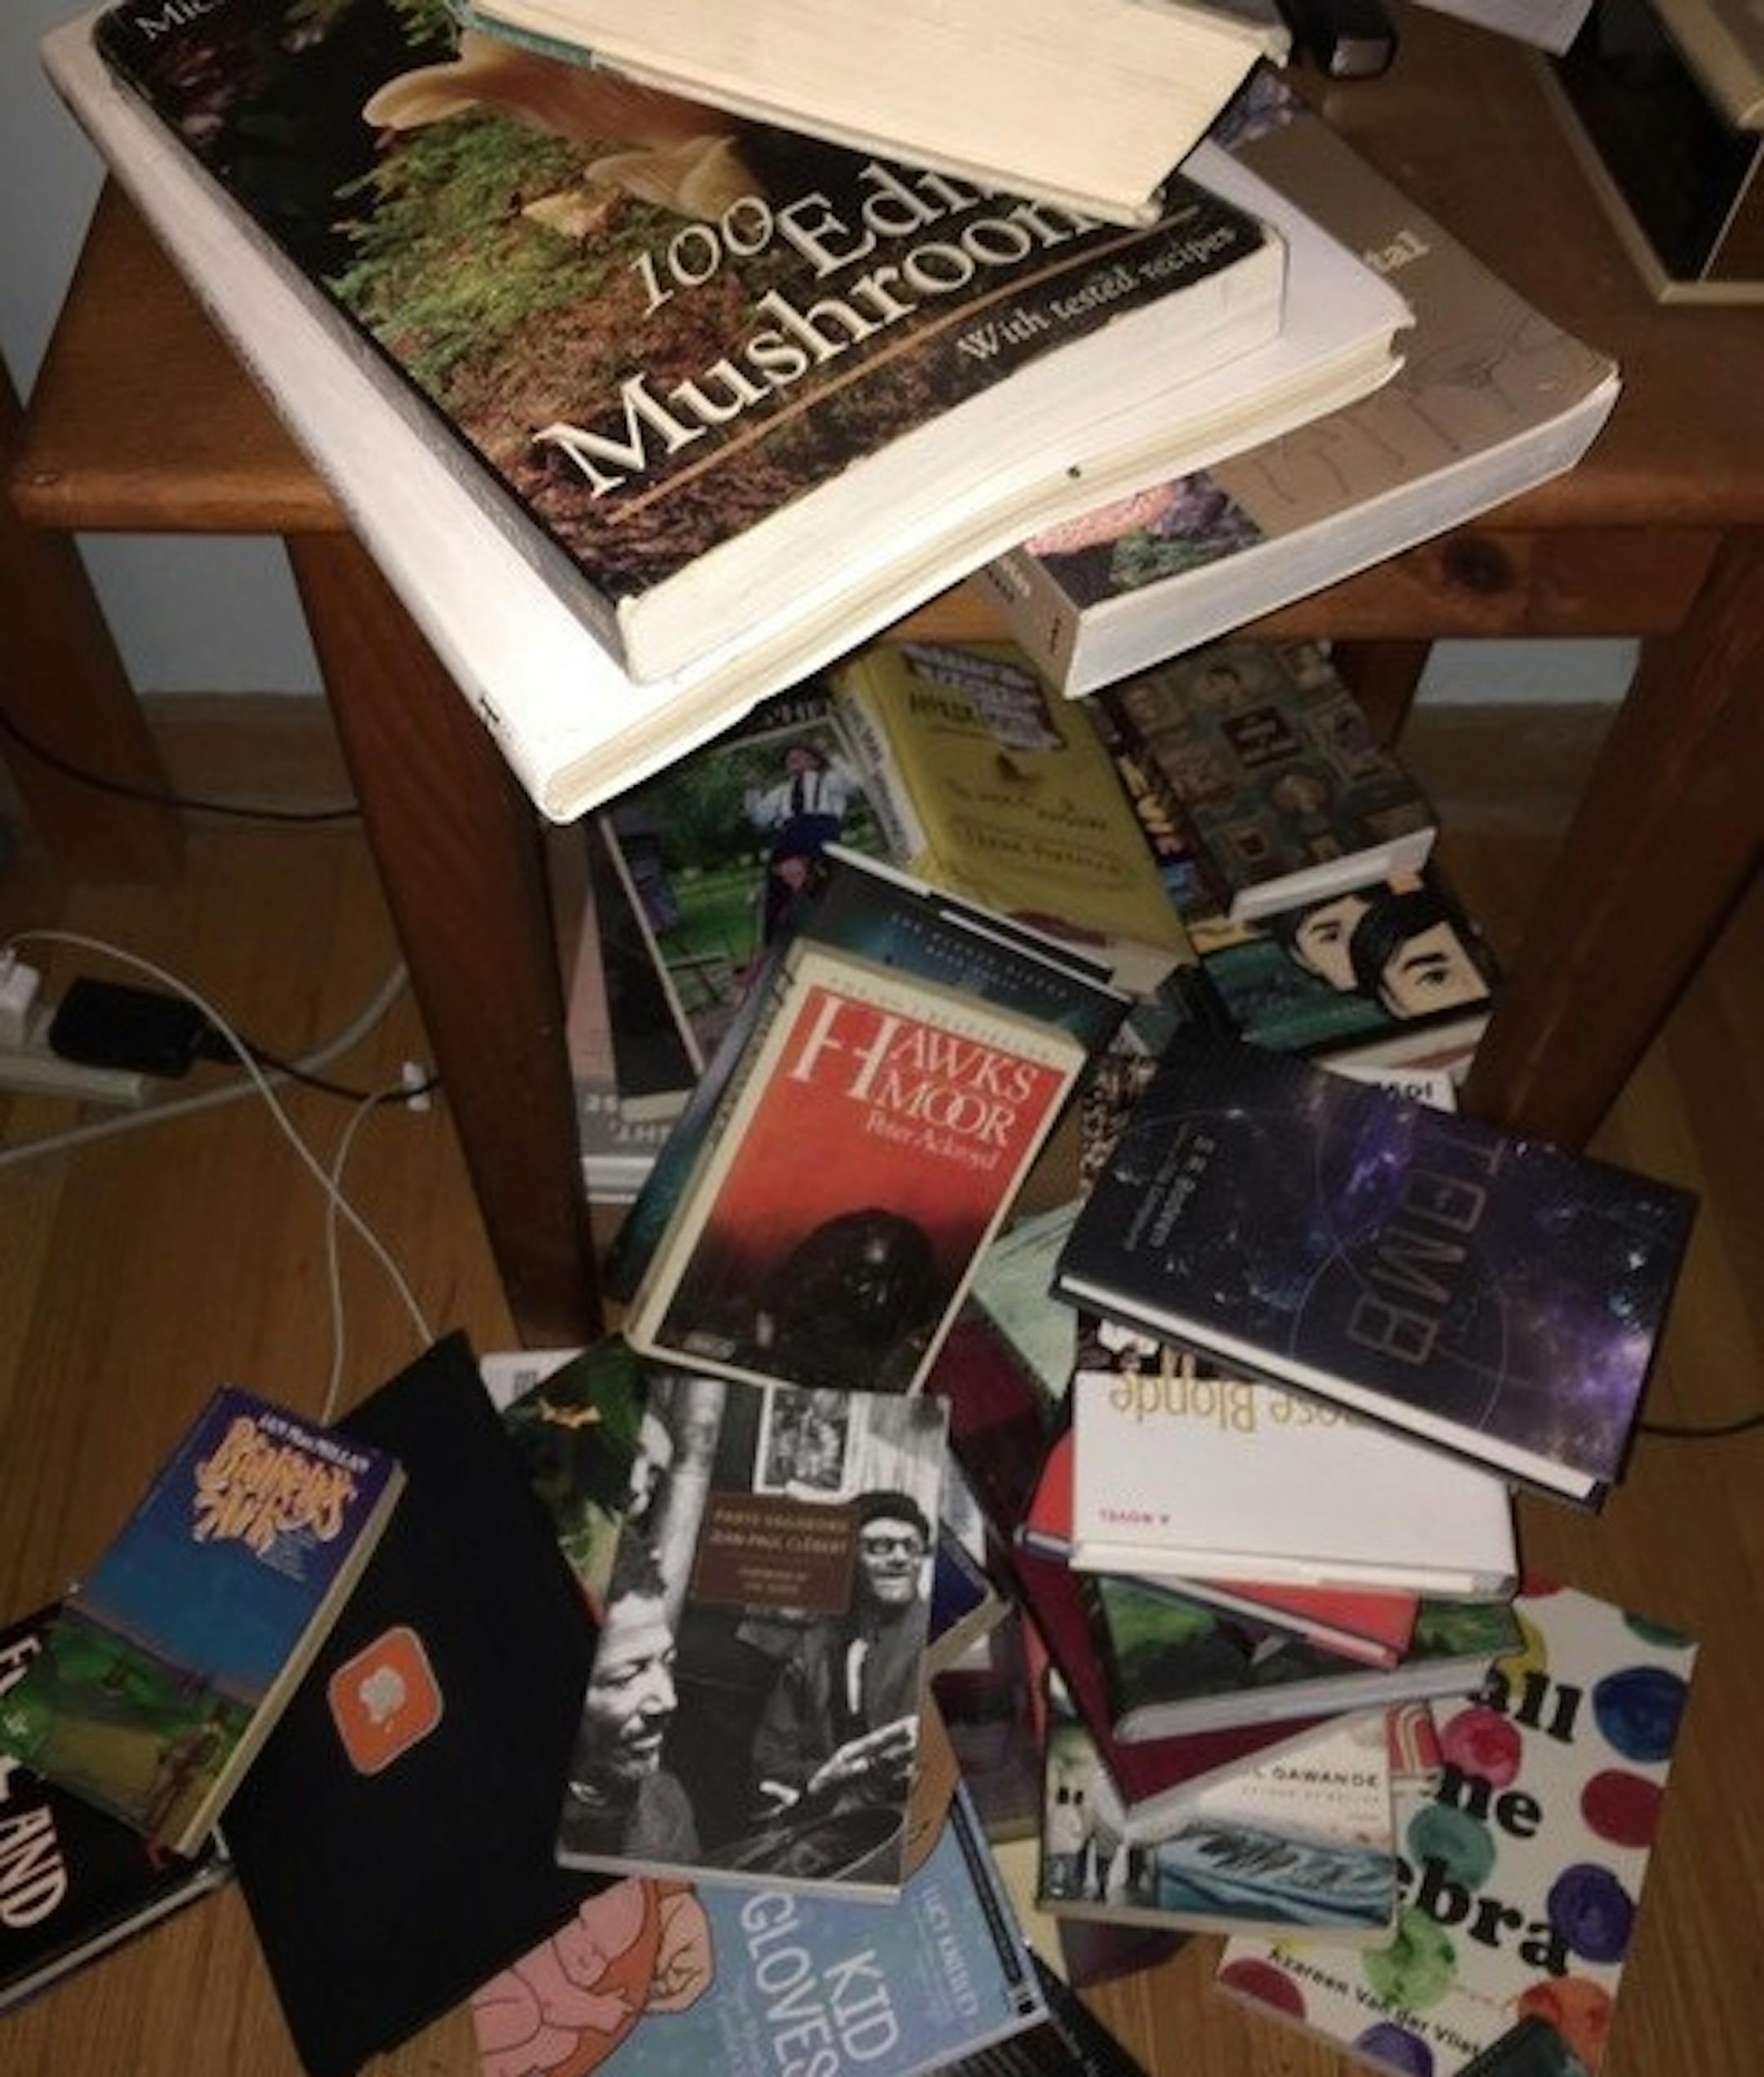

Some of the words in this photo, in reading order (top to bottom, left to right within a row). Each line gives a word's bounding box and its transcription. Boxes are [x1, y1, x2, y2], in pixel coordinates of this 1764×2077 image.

[134, 0, 222, 41] Mic
[629, 195, 774, 319] 100
[777, 161, 996, 279] Edi
[1364, 229, 1430, 274] tal
[956, 307, 1052, 359] With
[1049, 265, 1140, 319] tested
[1138, 225, 1238, 281] recipes
[789, 996, 1040, 1103] HAWKS
[874, 1068, 1016, 1147] MOOR
[1107, 1374, 1258, 1434] Blonde
[1271, 1765, 1379, 1789] GAWANDE
[740, 1891, 841, 2077] GLOVES
[823, 1947, 900, 2061] KID
